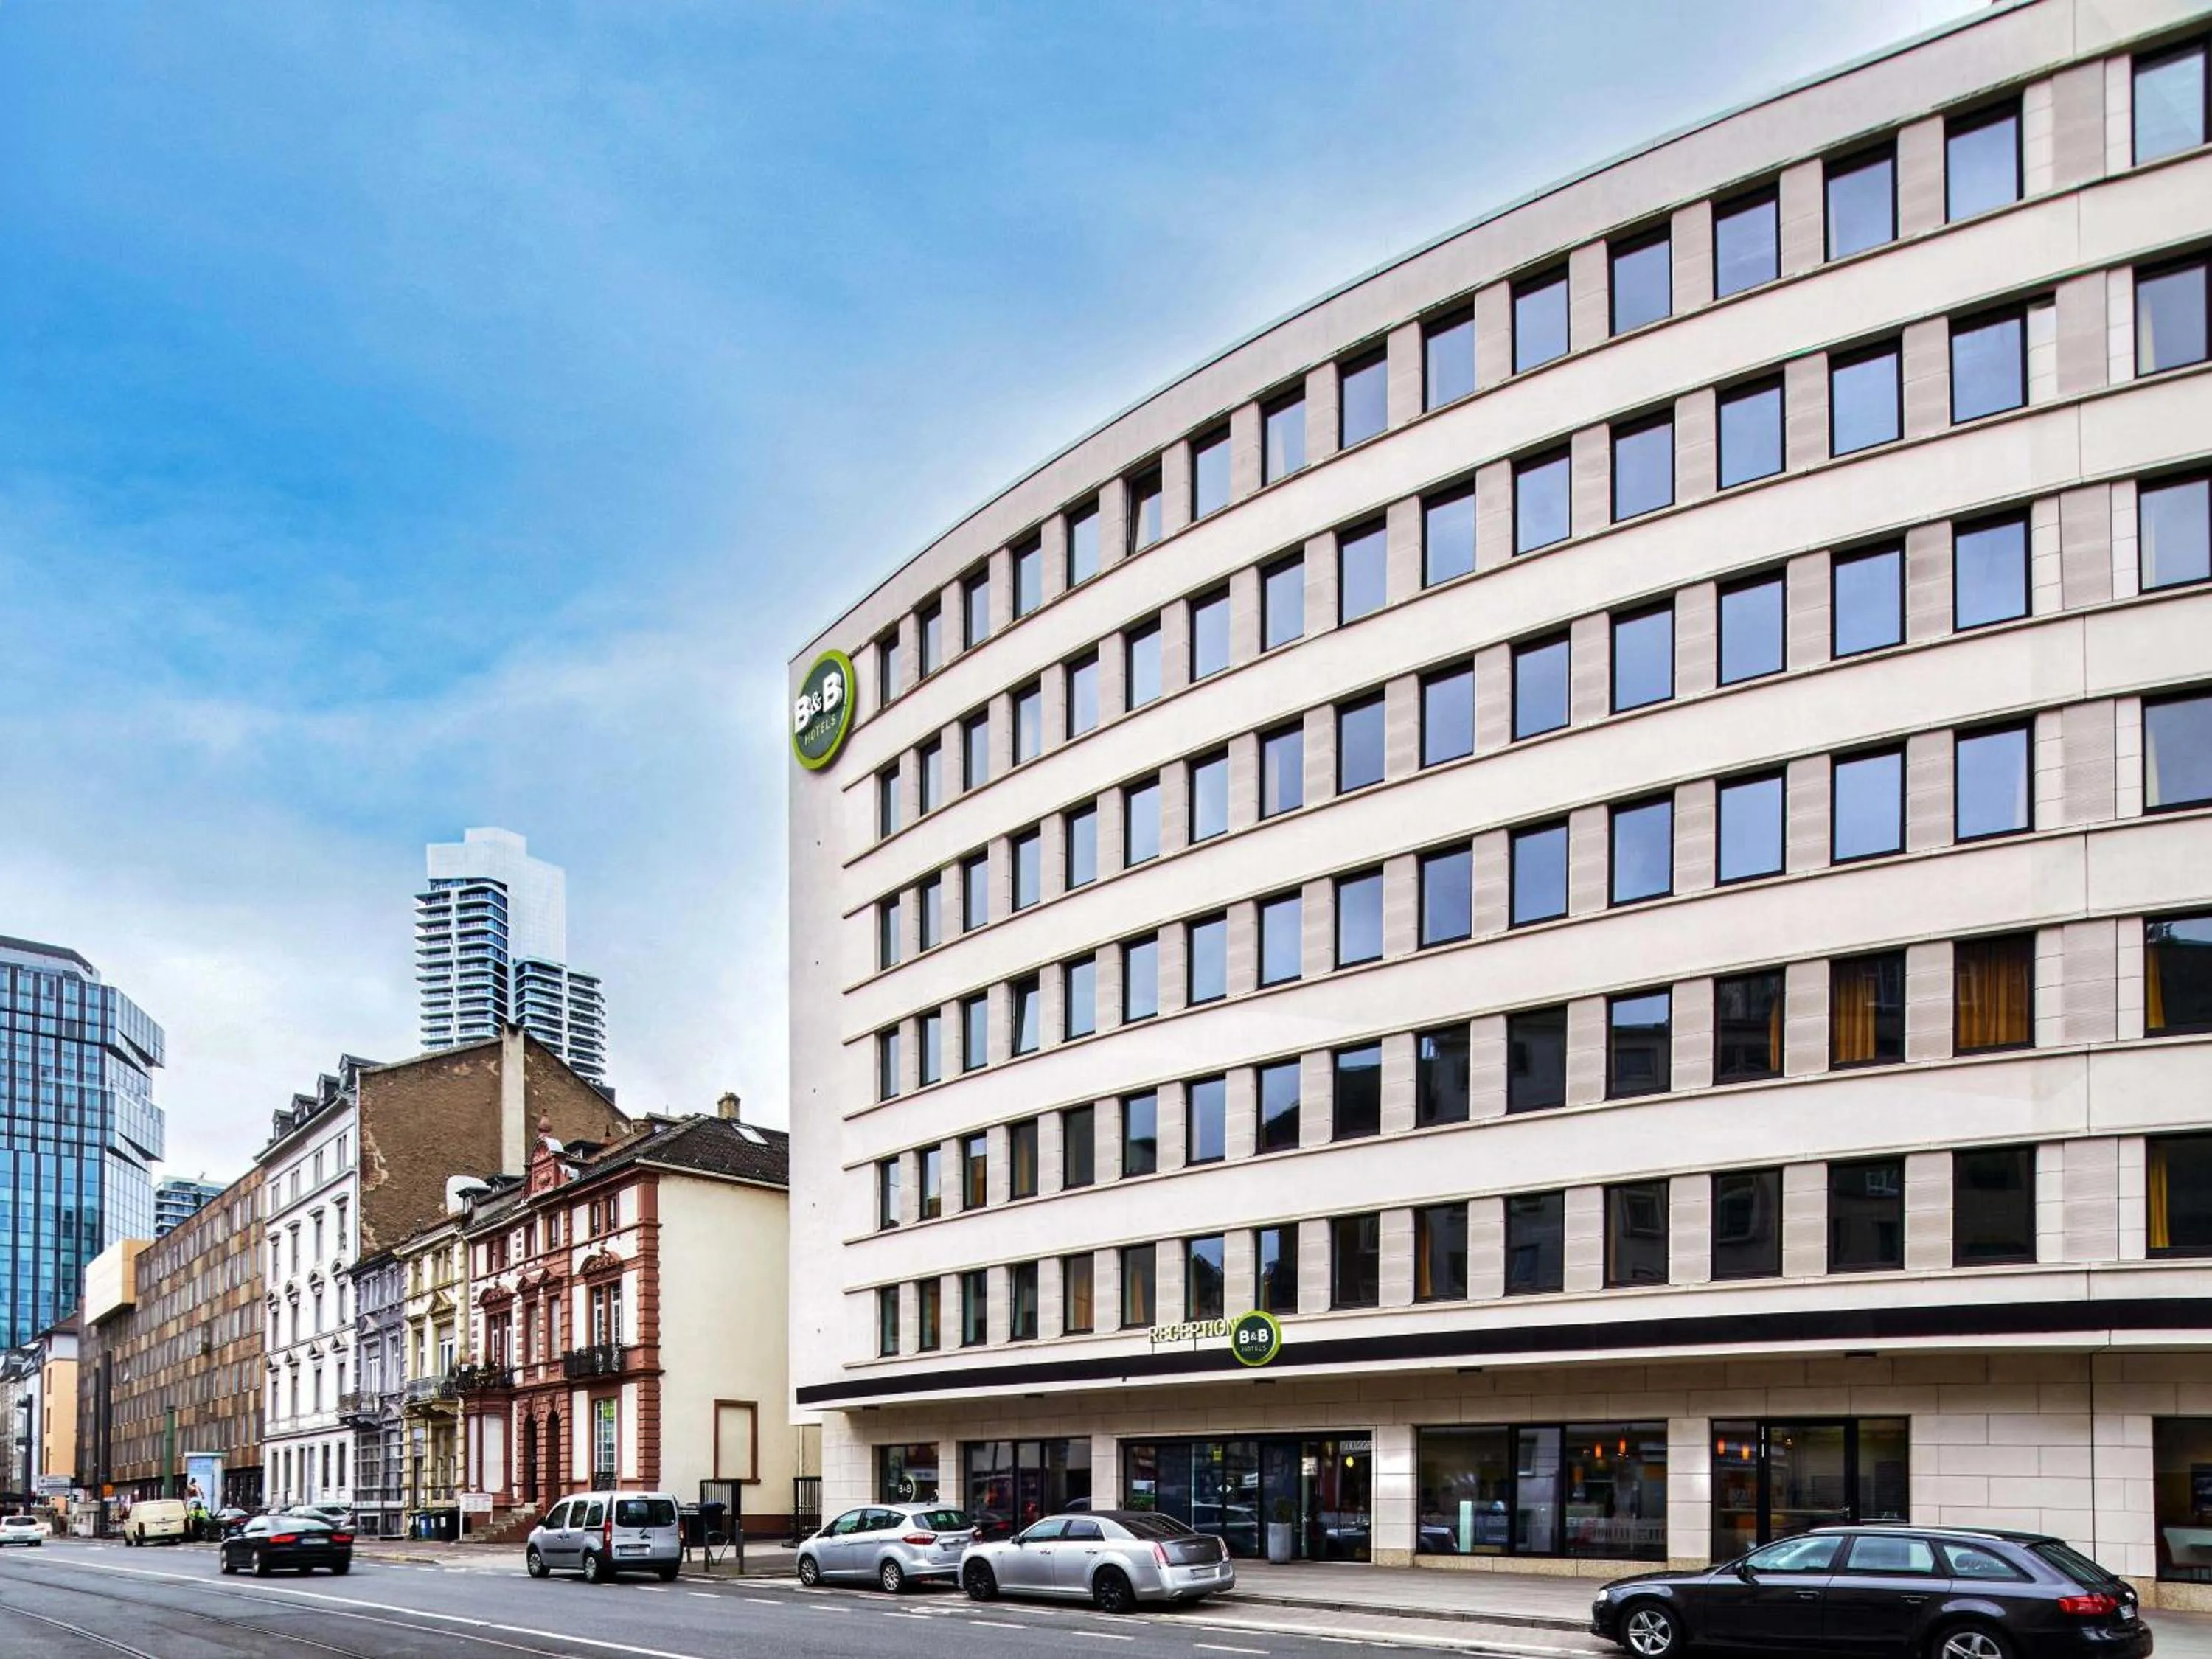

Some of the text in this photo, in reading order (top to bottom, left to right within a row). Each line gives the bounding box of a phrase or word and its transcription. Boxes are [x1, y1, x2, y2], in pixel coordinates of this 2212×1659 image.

[794, 672, 843, 734] B&B
[804, 714, 837, 746] HOTELS
[1239, 1328, 1269, 1344] B&B
[1241, 1344, 1268, 1352] HOTELS
